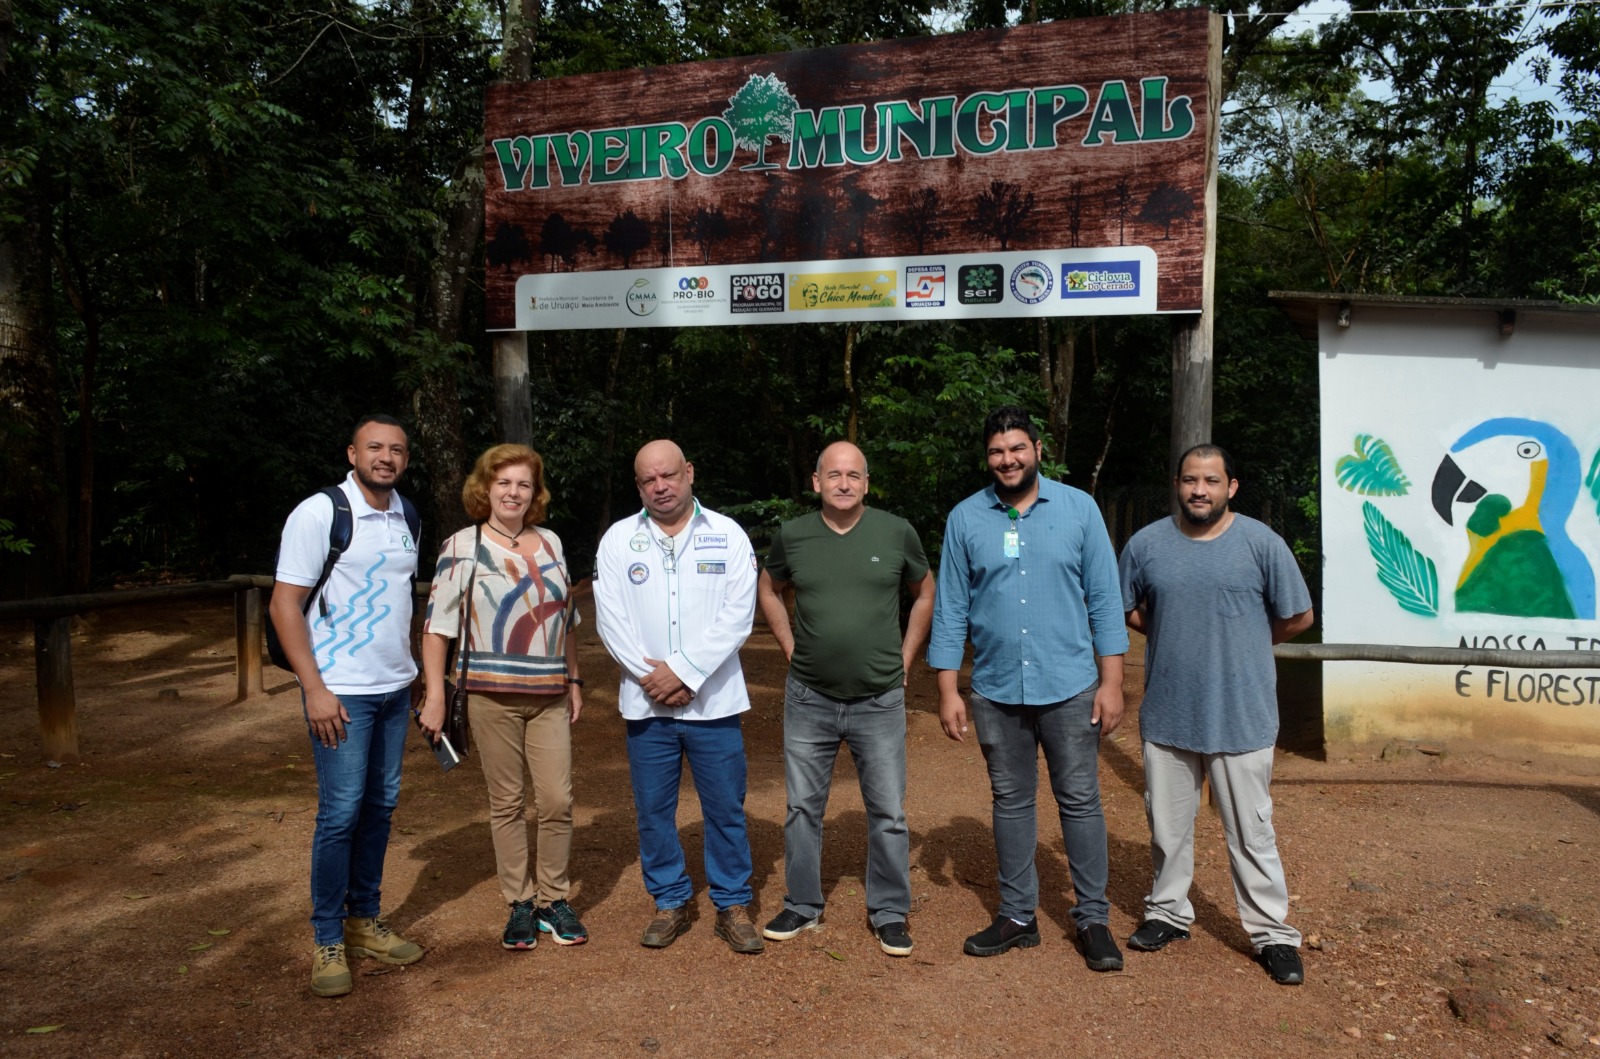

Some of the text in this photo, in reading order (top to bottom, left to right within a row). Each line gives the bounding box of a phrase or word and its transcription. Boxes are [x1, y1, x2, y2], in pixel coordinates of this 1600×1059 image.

[492, 75, 1195, 192] VIVEIRO MUNICIPAL
[732, 275, 781, 286] CONTRA
[1088, 271, 1130, 282] Ciclovia
[1101, 282, 1134, 290] Cerrado
[820, 290, 883, 304] Chico Mendes
[964, 288, 996, 297] ser
[551, 302, 579, 310] Uruaçu
[1455, 665, 1600, 706] É FLOREST
